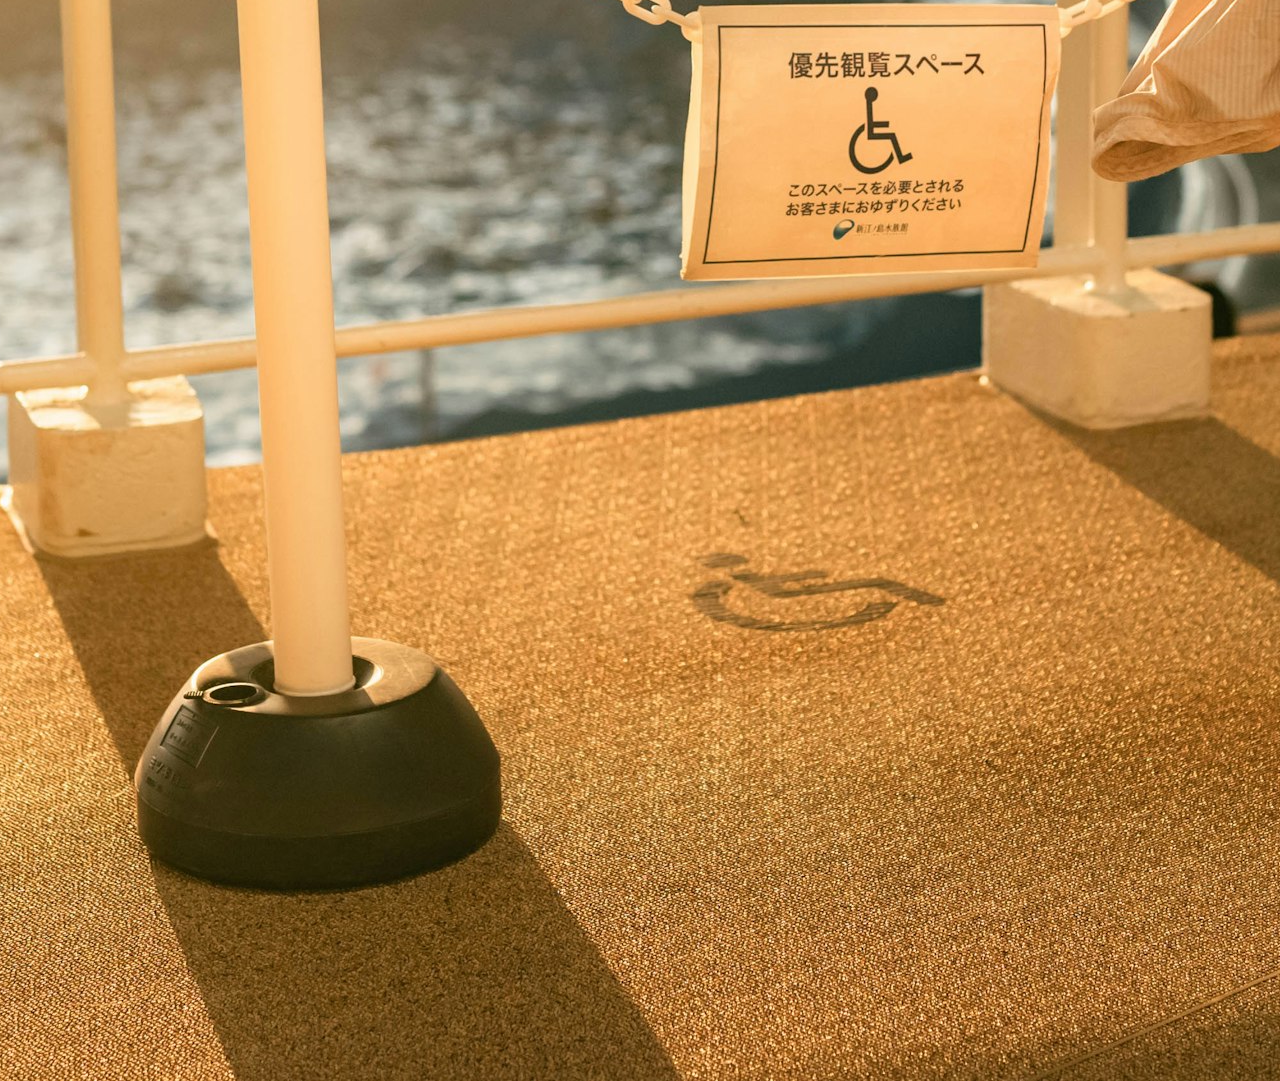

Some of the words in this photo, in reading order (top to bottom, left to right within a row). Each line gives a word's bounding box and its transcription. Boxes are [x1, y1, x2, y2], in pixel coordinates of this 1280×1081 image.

[787, 51, 986, 80] 優先観覧スペース
[787, 179, 965, 198] このスペースを必要とされる
[785, 198, 962, 217] お客さまにおゆずりください
